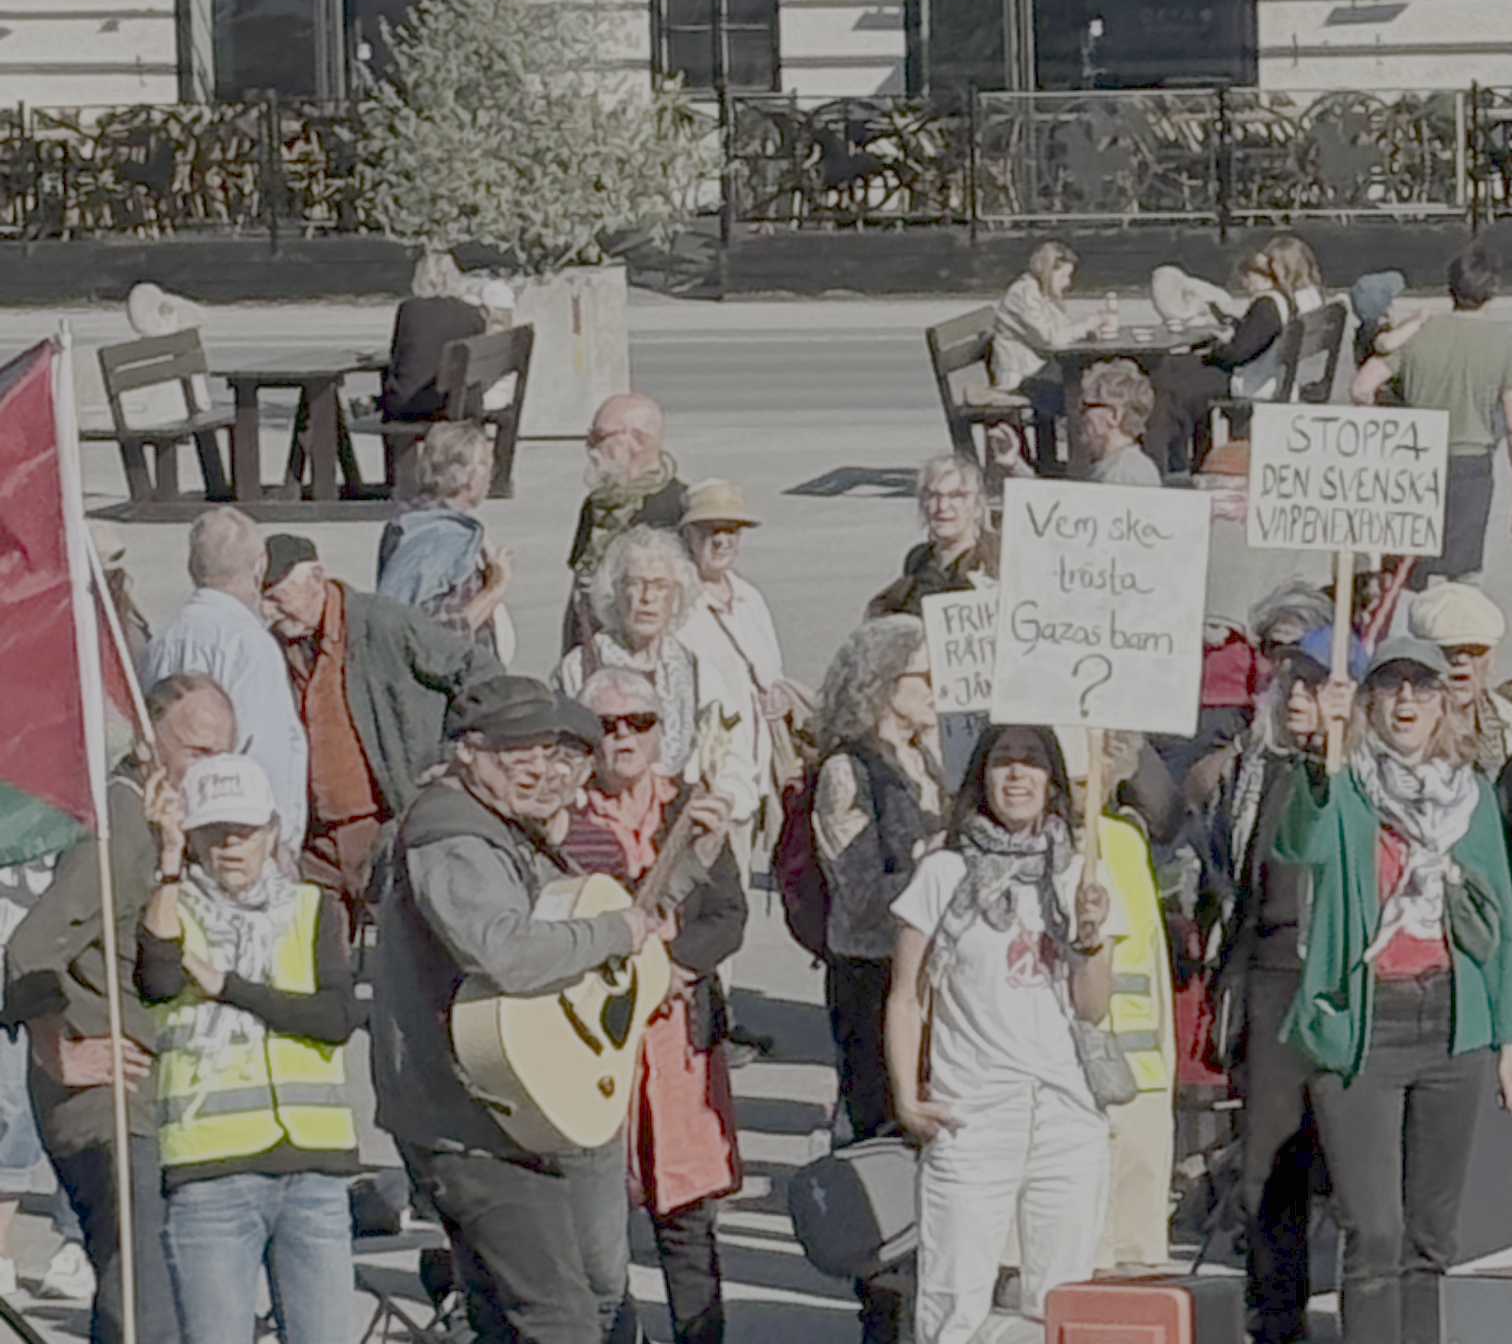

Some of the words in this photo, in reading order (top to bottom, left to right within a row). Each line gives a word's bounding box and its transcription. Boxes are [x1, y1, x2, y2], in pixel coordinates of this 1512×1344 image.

[1287, 414, 1431, 461] STOPPA
[1260, 463, 1311, 500] DEN
[1319, 464, 1440, 509] SVENSKA
[1025, 500, 1098, 547] Vem
[1108, 507, 1175, 549] ska
[1255, 504, 1438, 549] VAPENEXPORTEN
[1010, 599, 1102, 656] Gazas
[1109, 609, 1174, 655] barn
[1071, 653, 1114, 719] ?
